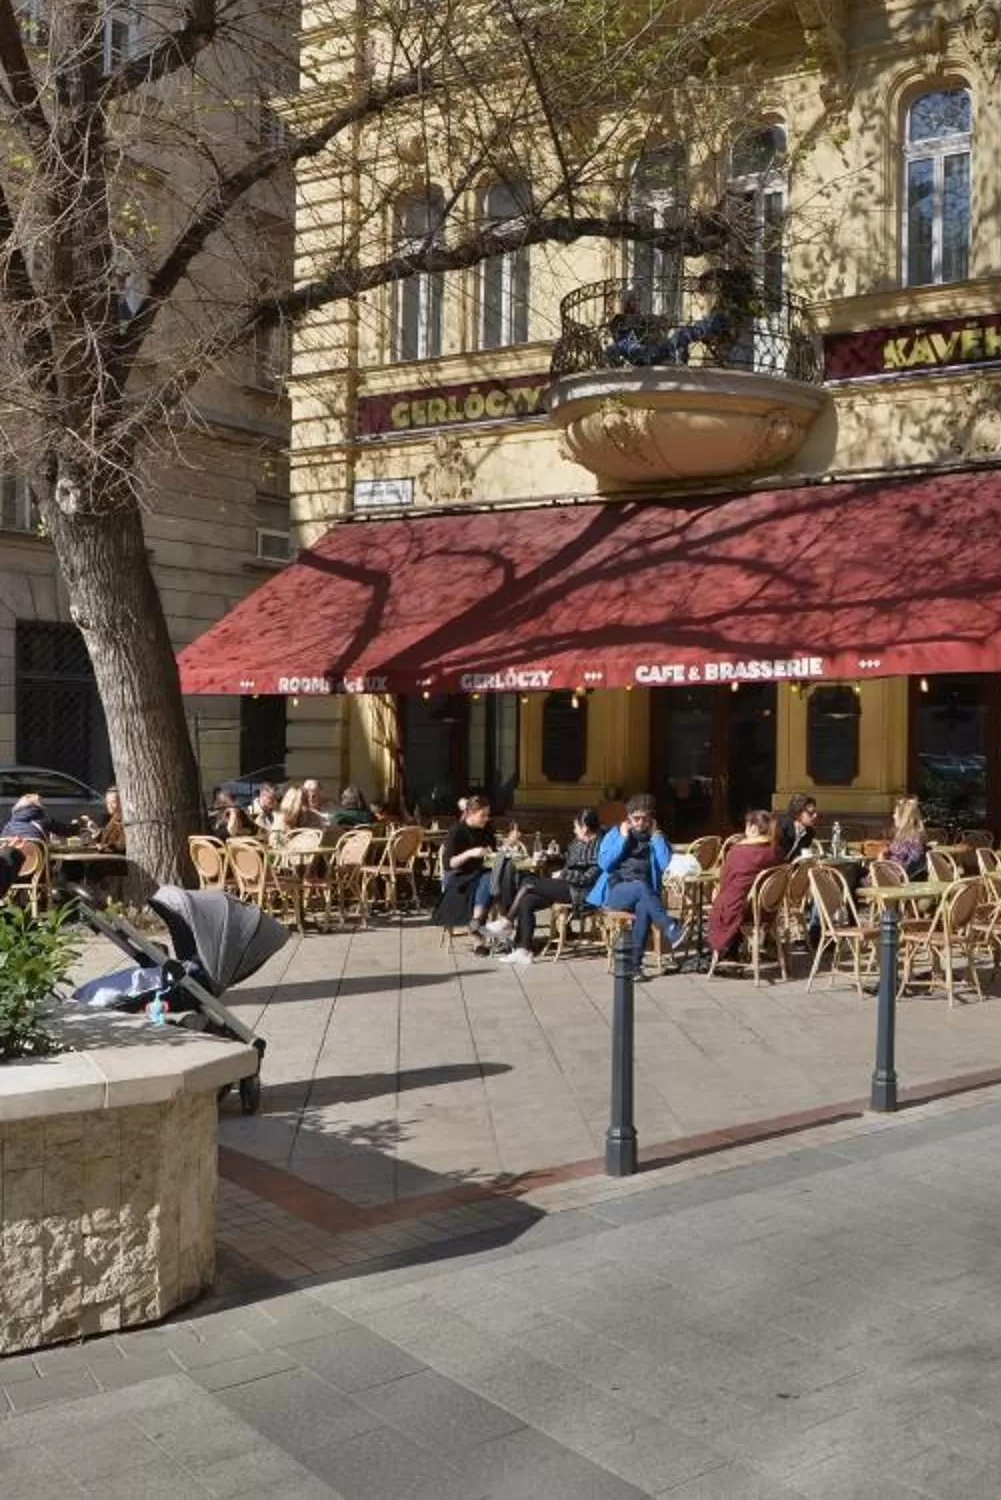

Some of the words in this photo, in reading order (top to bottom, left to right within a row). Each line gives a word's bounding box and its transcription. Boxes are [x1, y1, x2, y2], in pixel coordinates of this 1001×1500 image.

[461, 667, 553, 690] GERLÓCZY
[687, 666, 701, 681] &
[705, 657, 823, 681] BRASSERIE
